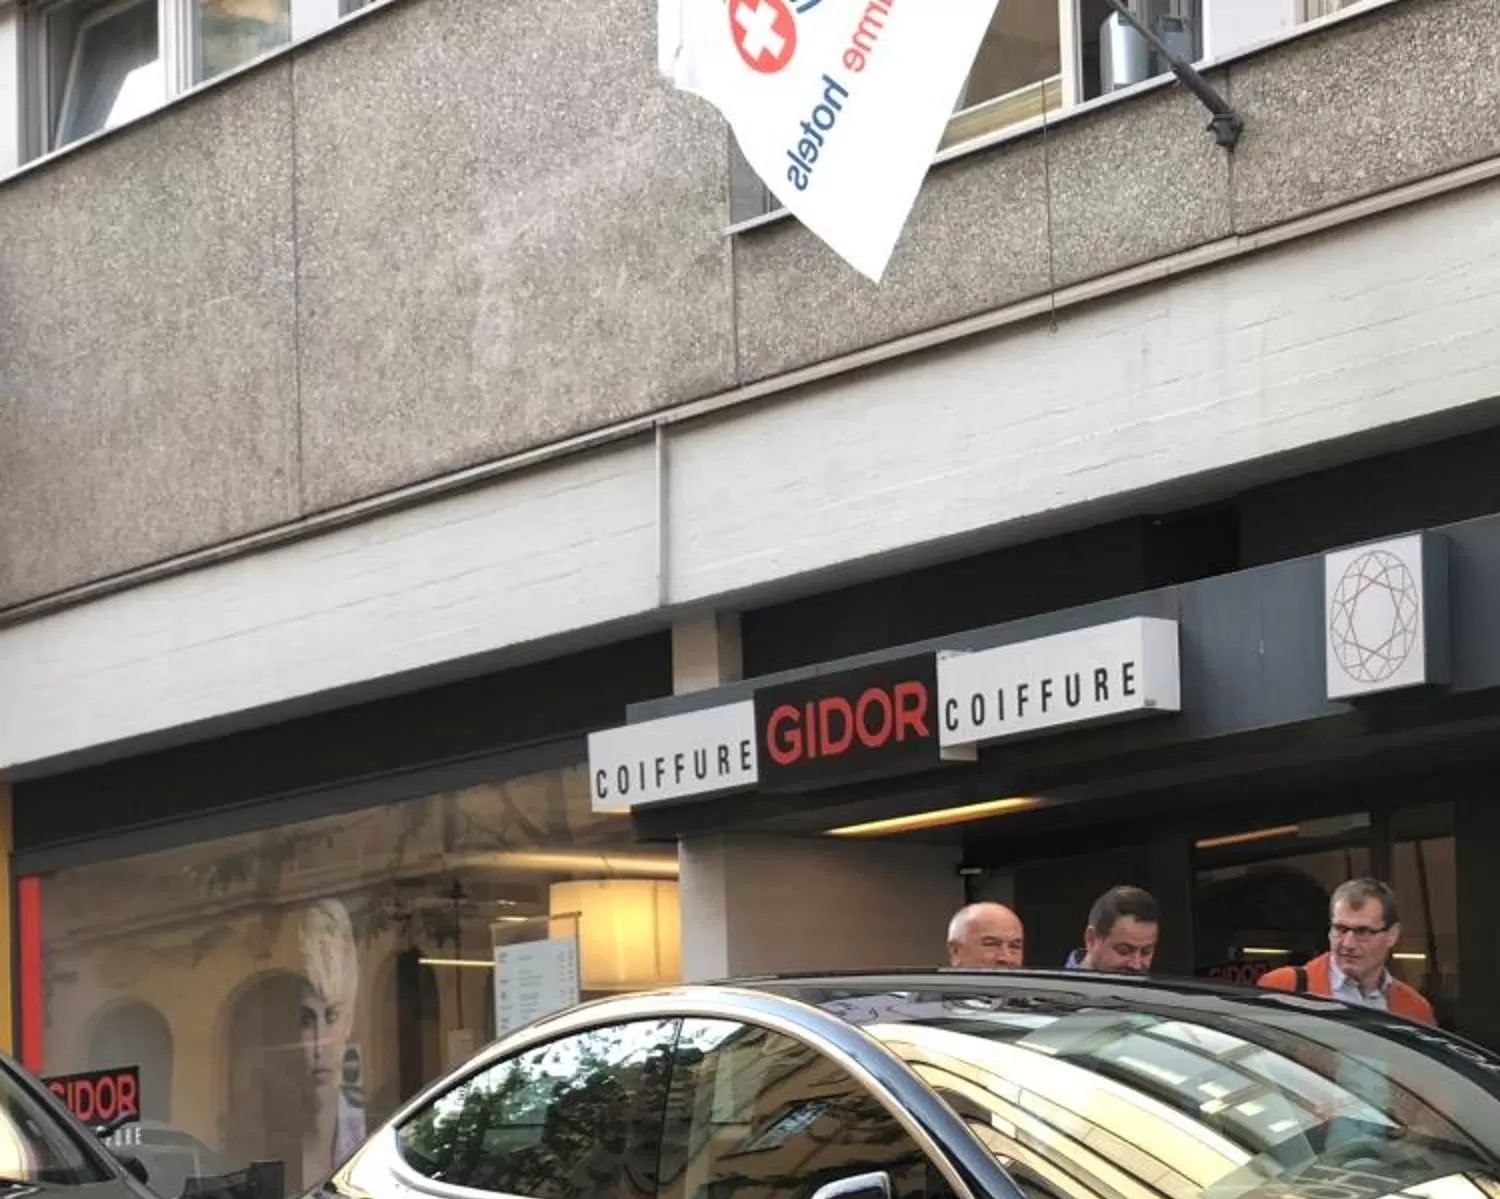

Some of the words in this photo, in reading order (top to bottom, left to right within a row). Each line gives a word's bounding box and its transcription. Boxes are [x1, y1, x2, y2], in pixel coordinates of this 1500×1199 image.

[595, 739, 751, 797] COIFFURE
[766, 680, 929, 765] GIDOR
[946, 661, 1136, 732] COIFFURE
